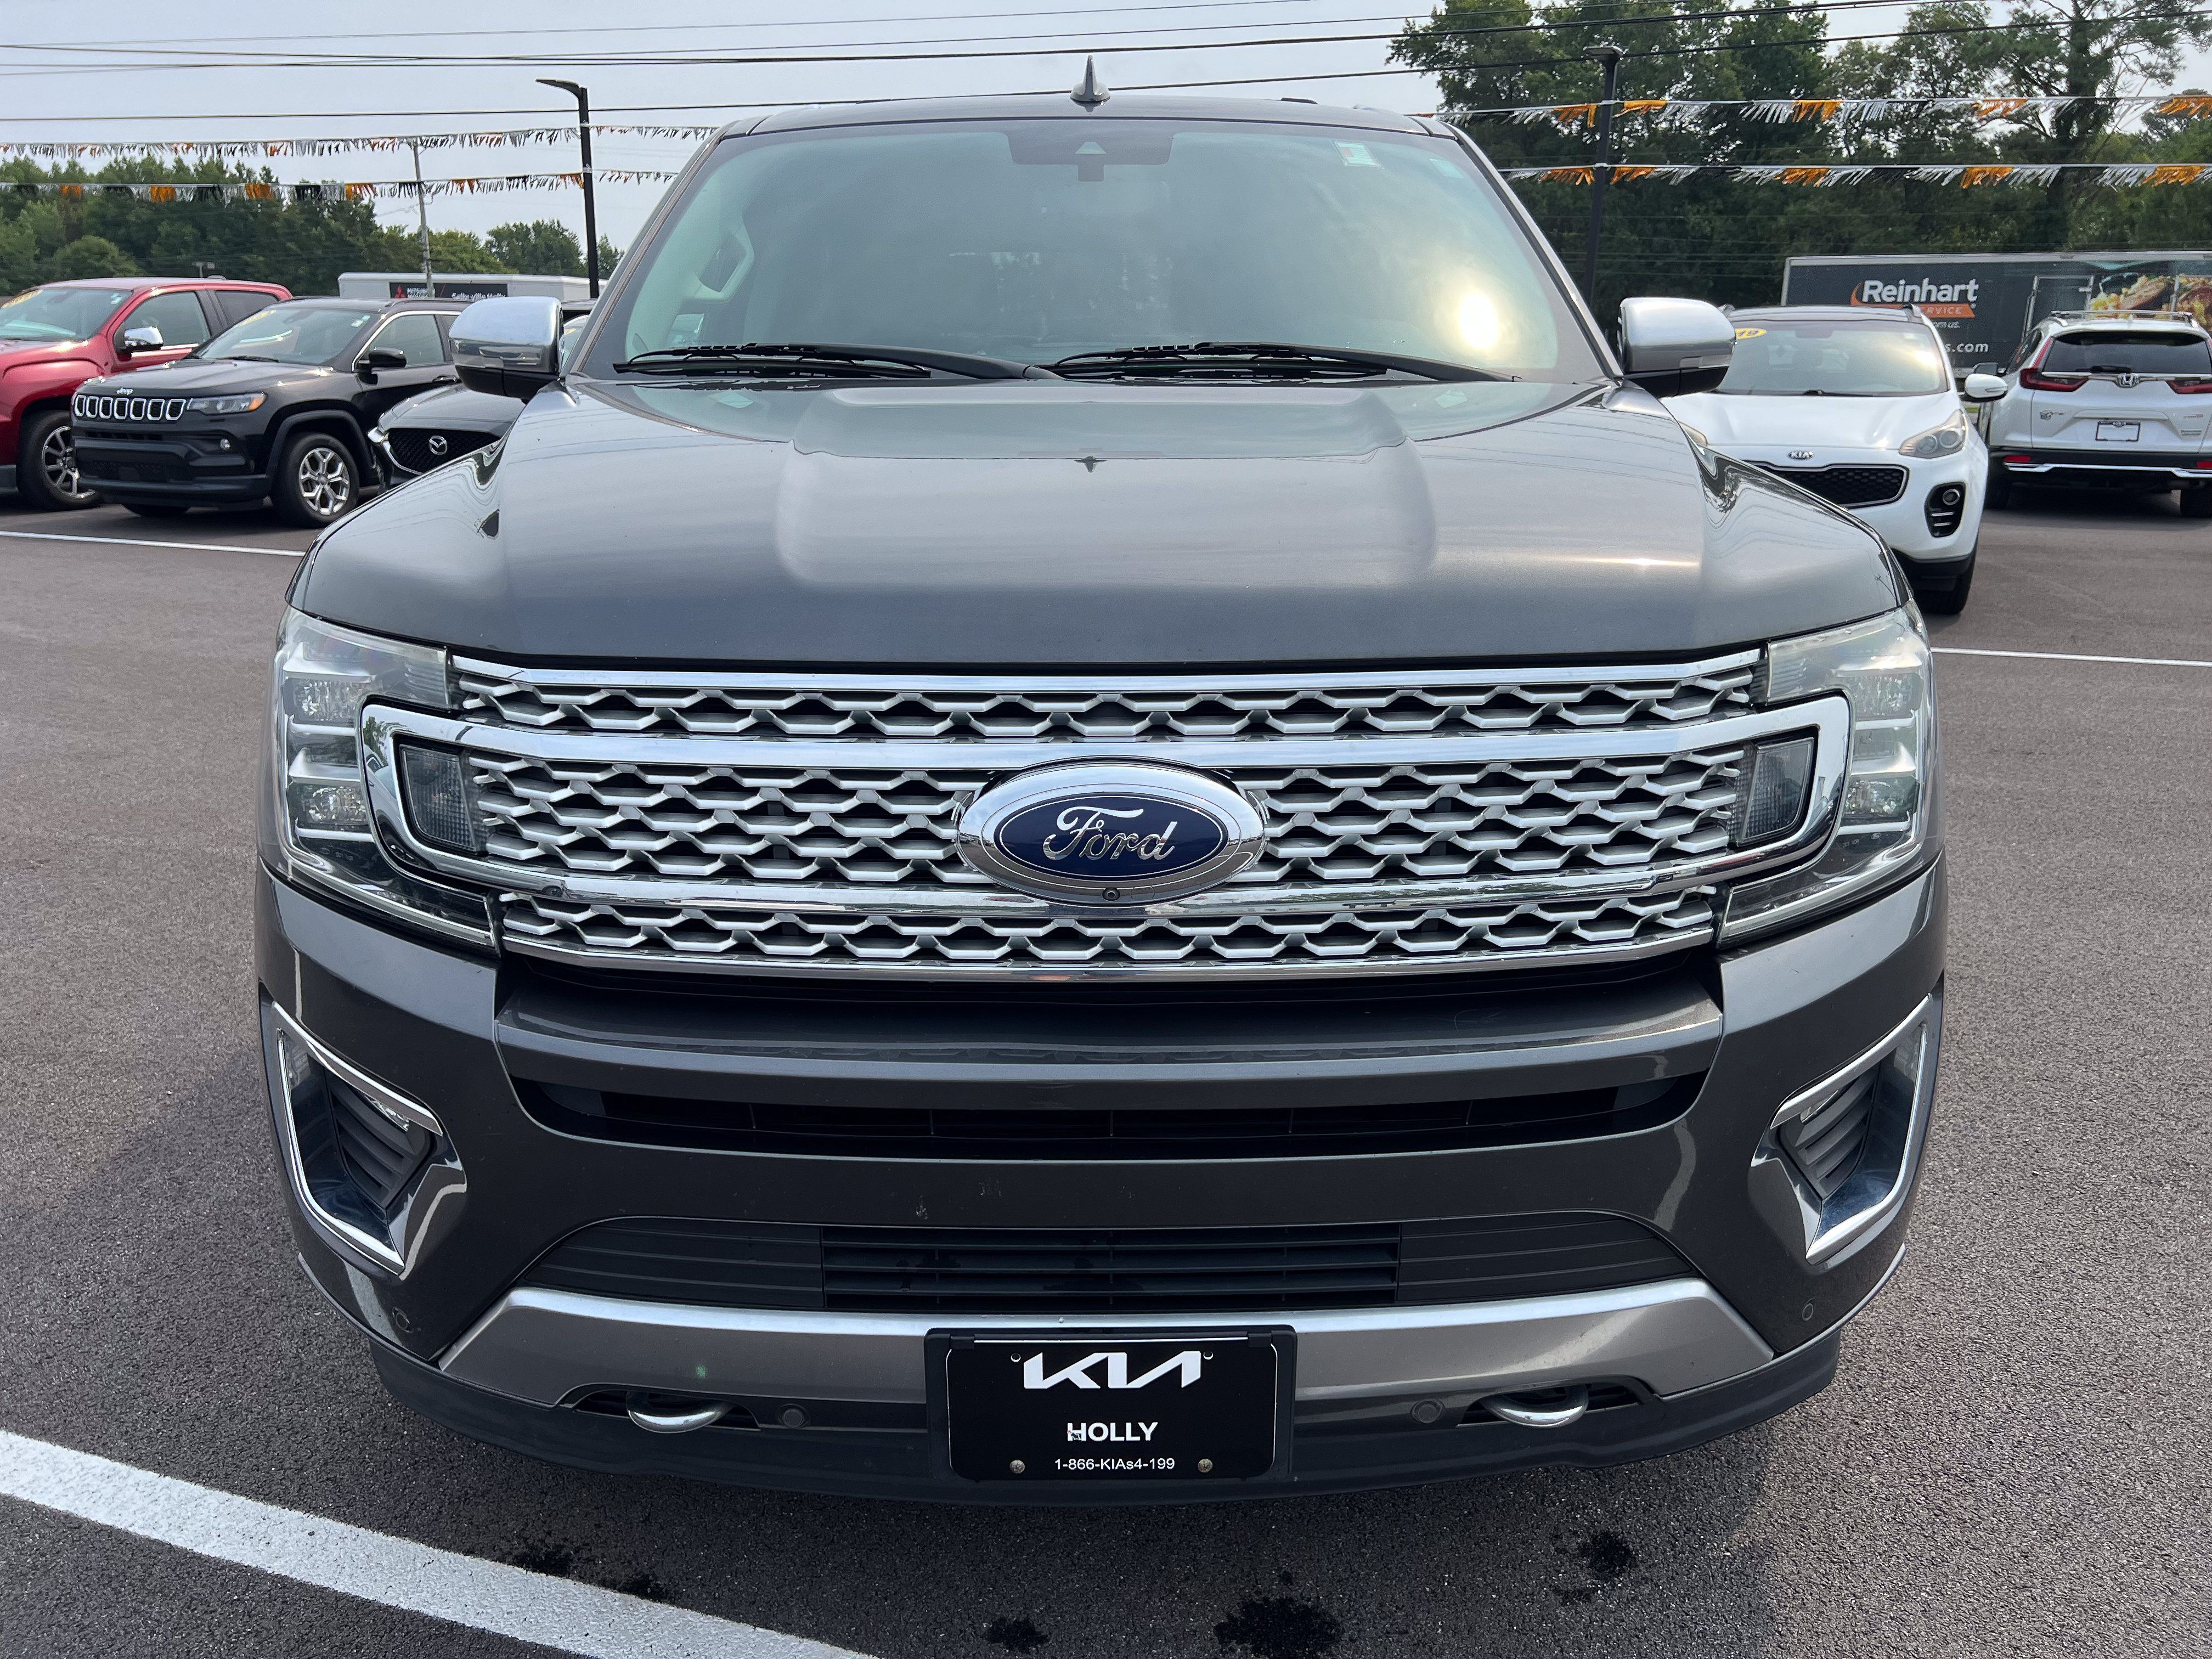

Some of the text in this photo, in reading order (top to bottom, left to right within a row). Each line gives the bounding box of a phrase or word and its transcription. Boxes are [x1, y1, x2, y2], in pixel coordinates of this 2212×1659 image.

[1862, 278, 1979, 302] Reinhart
[1944, 343, 1989, 353] s.com
[1043, 805, 1178, 860] Ford
[1023, 1351, 1201, 1389] KIA
[1067, 1422, 1158, 1442] HOLLY
[1054, 1458, 1175, 1470] 1-866-KIAs4-199
